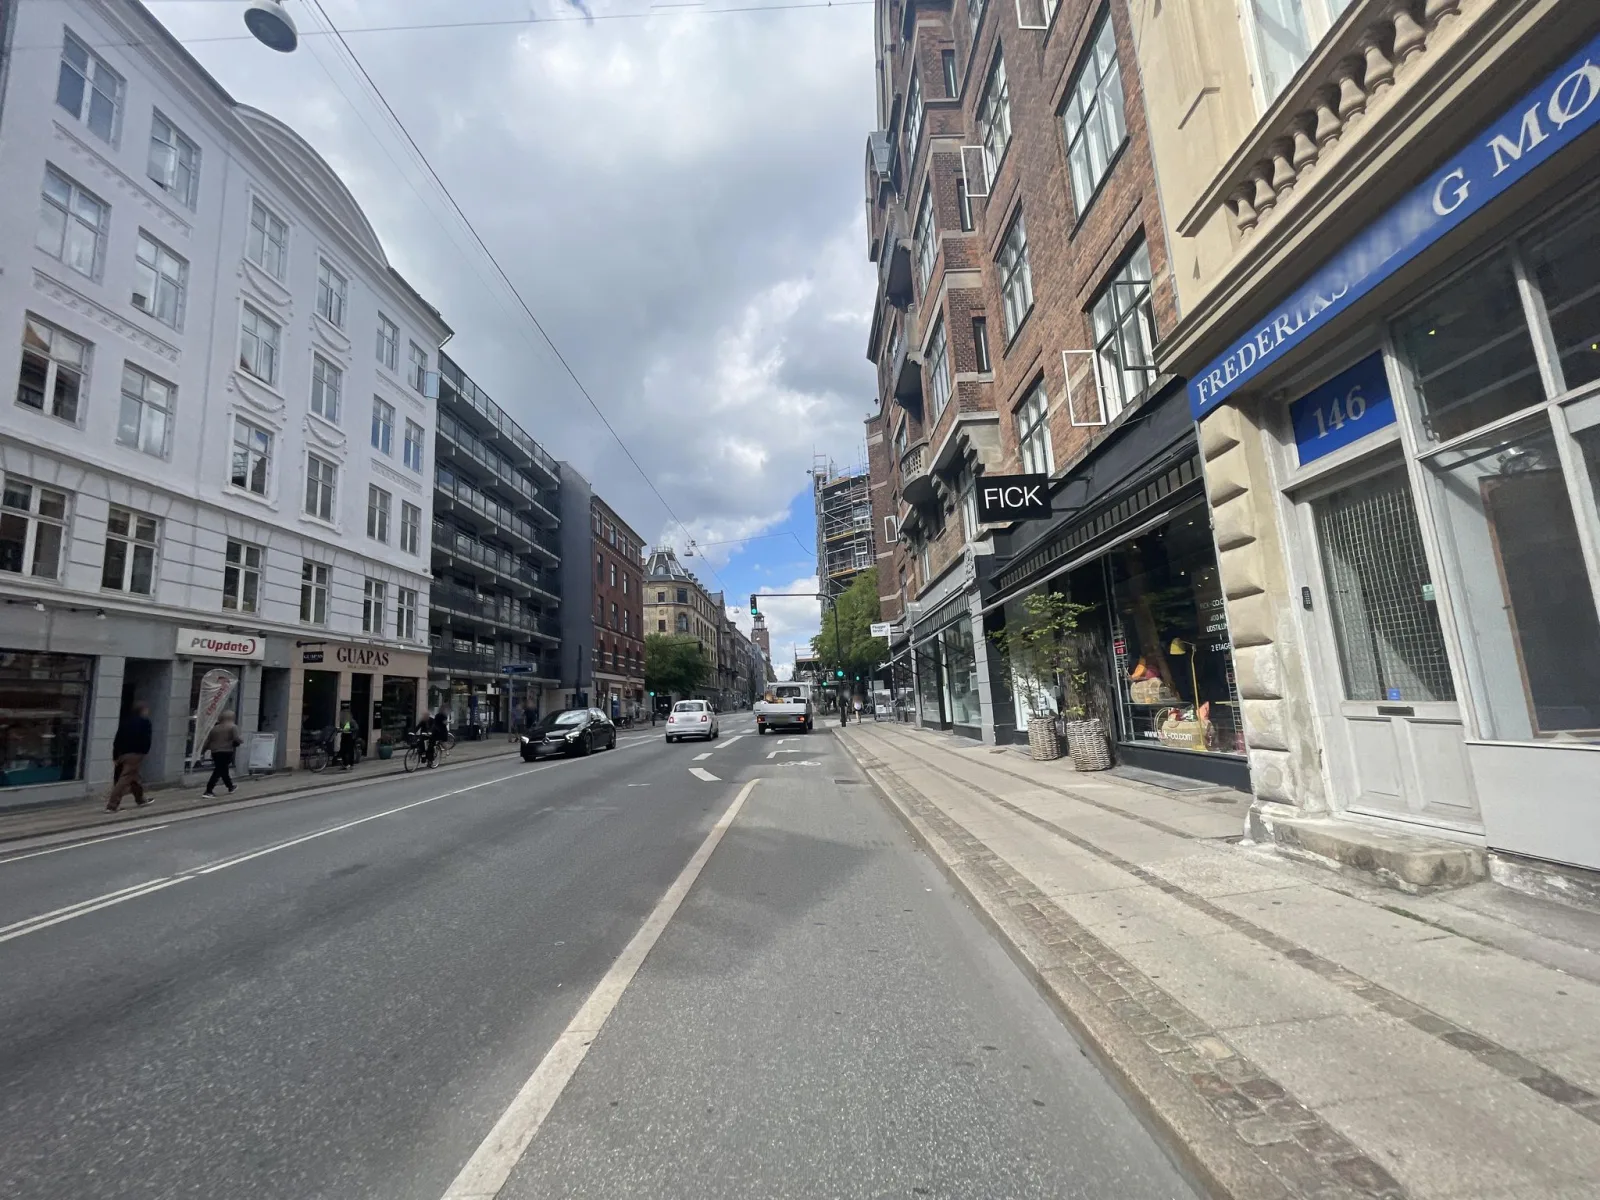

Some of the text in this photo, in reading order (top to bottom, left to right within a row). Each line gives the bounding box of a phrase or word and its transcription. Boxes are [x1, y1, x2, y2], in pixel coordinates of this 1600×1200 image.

[1313, 385, 1366, 439] 146
[984, 485, 1043, 509] FICK
[336, 647, 390, 667] GUAPAS
